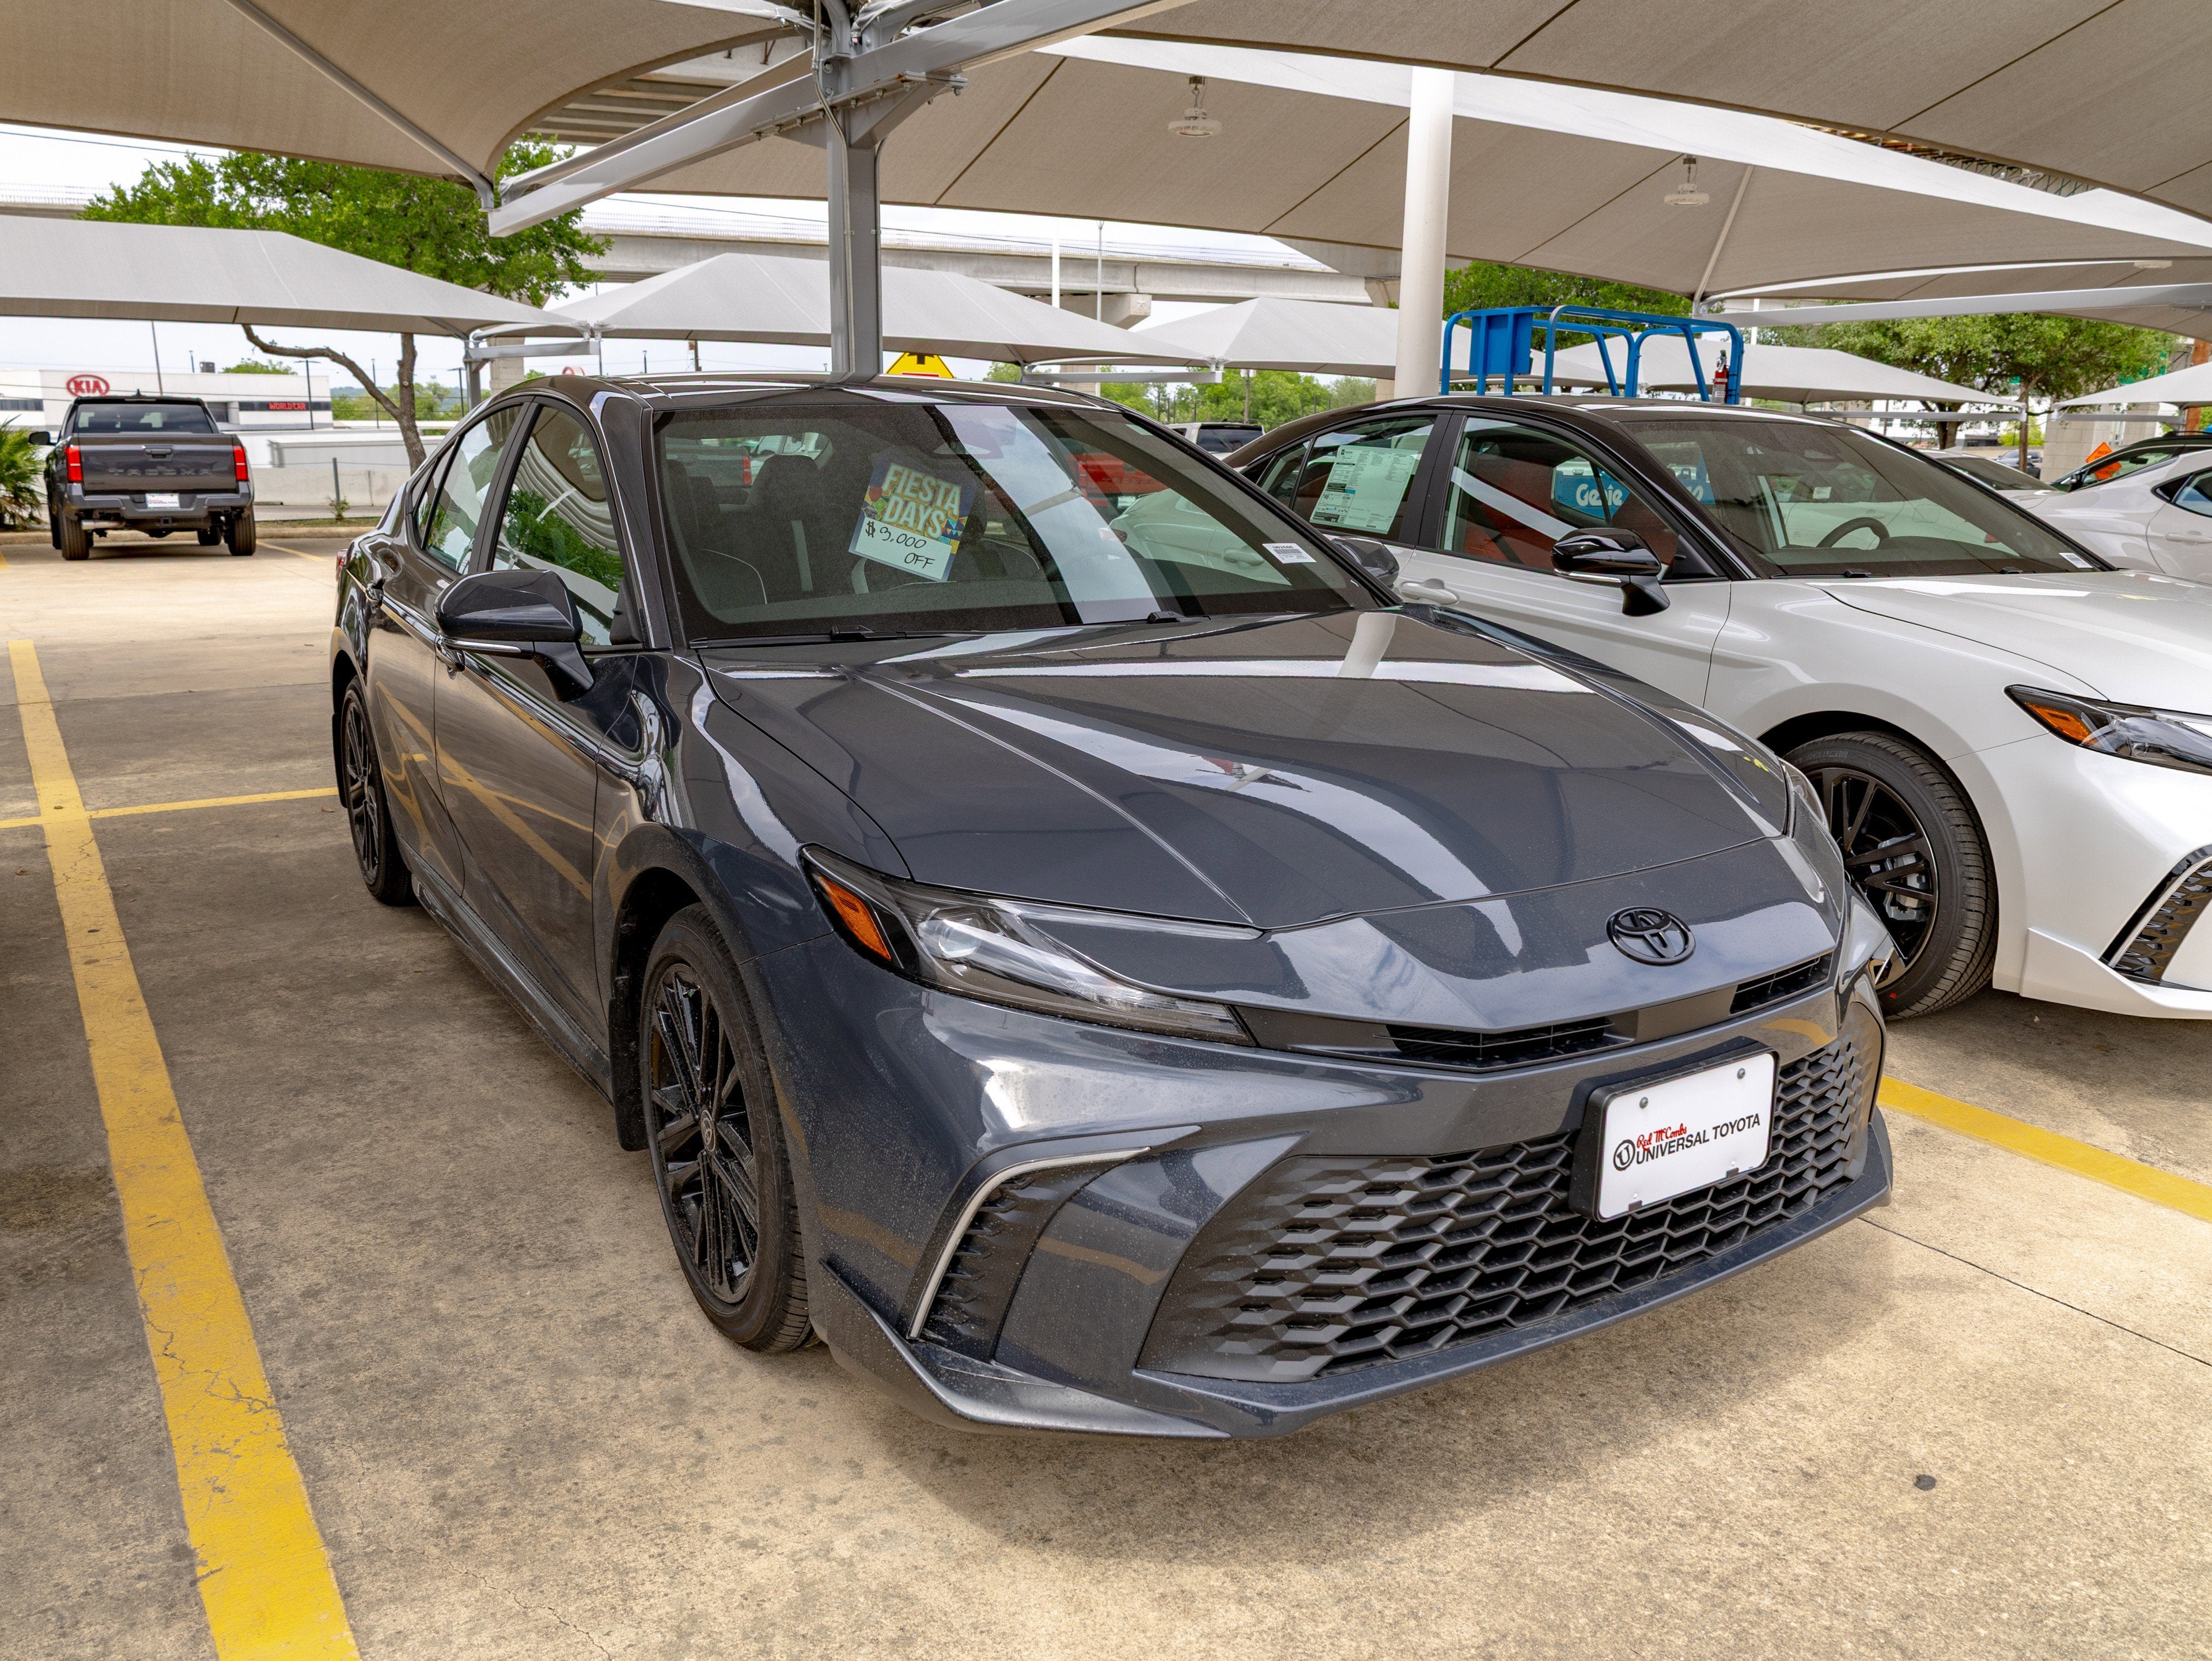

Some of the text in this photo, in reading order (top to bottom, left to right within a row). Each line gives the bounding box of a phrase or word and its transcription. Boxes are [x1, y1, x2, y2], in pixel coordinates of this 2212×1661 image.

[73, 380, 104, 395] KIA
[268, 402, 306, 410] WORLD CAR
[881, 463, 961, 517] FIESTA
[1576, 483, 1623, 506] Geie
[882, 495, 946, 540] DAYS
[904, 552, 935, 569] OFF
[1636, 1113, 1760, 1165] UNIVERSAL TOYOTA
[1637, 1123, 1687, 1151] Red McCombs
